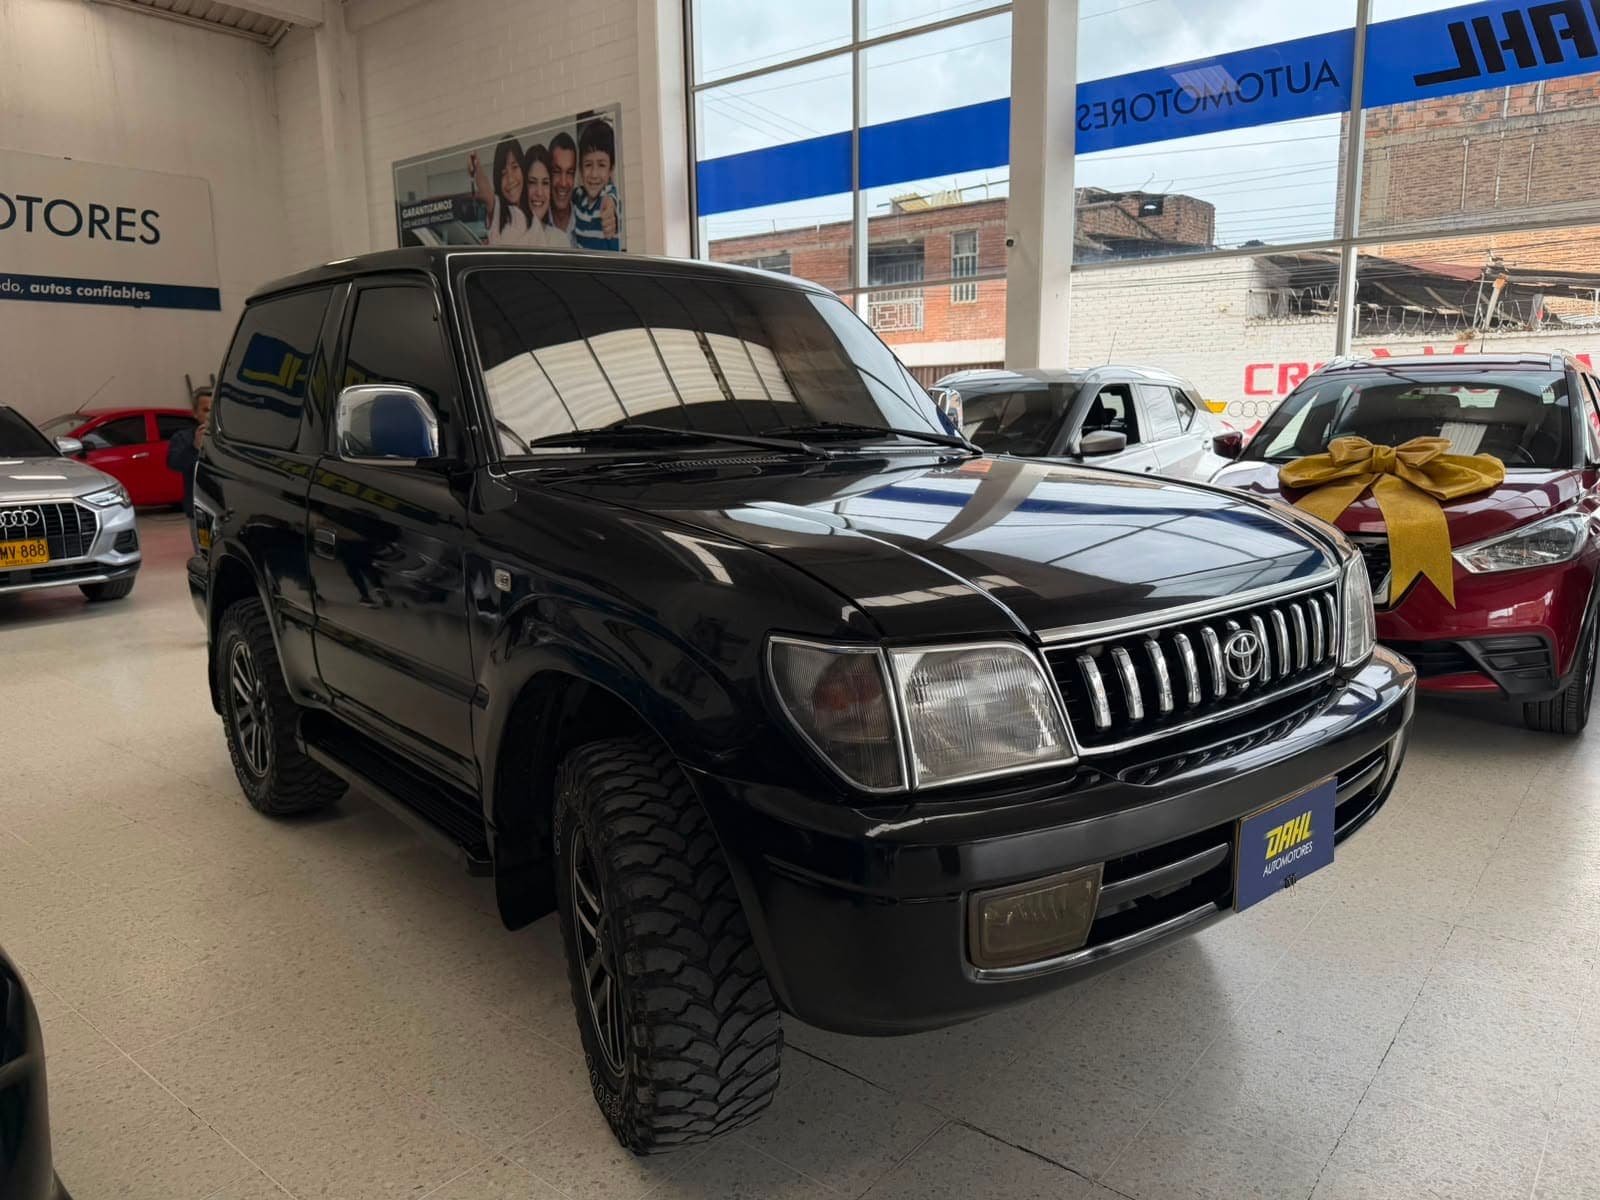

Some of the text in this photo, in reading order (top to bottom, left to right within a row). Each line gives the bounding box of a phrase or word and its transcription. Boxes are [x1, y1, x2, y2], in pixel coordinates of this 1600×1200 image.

[0, 278, 151, 300] do, autos confiables
[1244, 362, 1327, 395] CR
[20, 543, 46, 558] 888
[1264, 811, 1313, 860] DAHL
[1263, 841, 1313, 877] AUTOMOTORES
